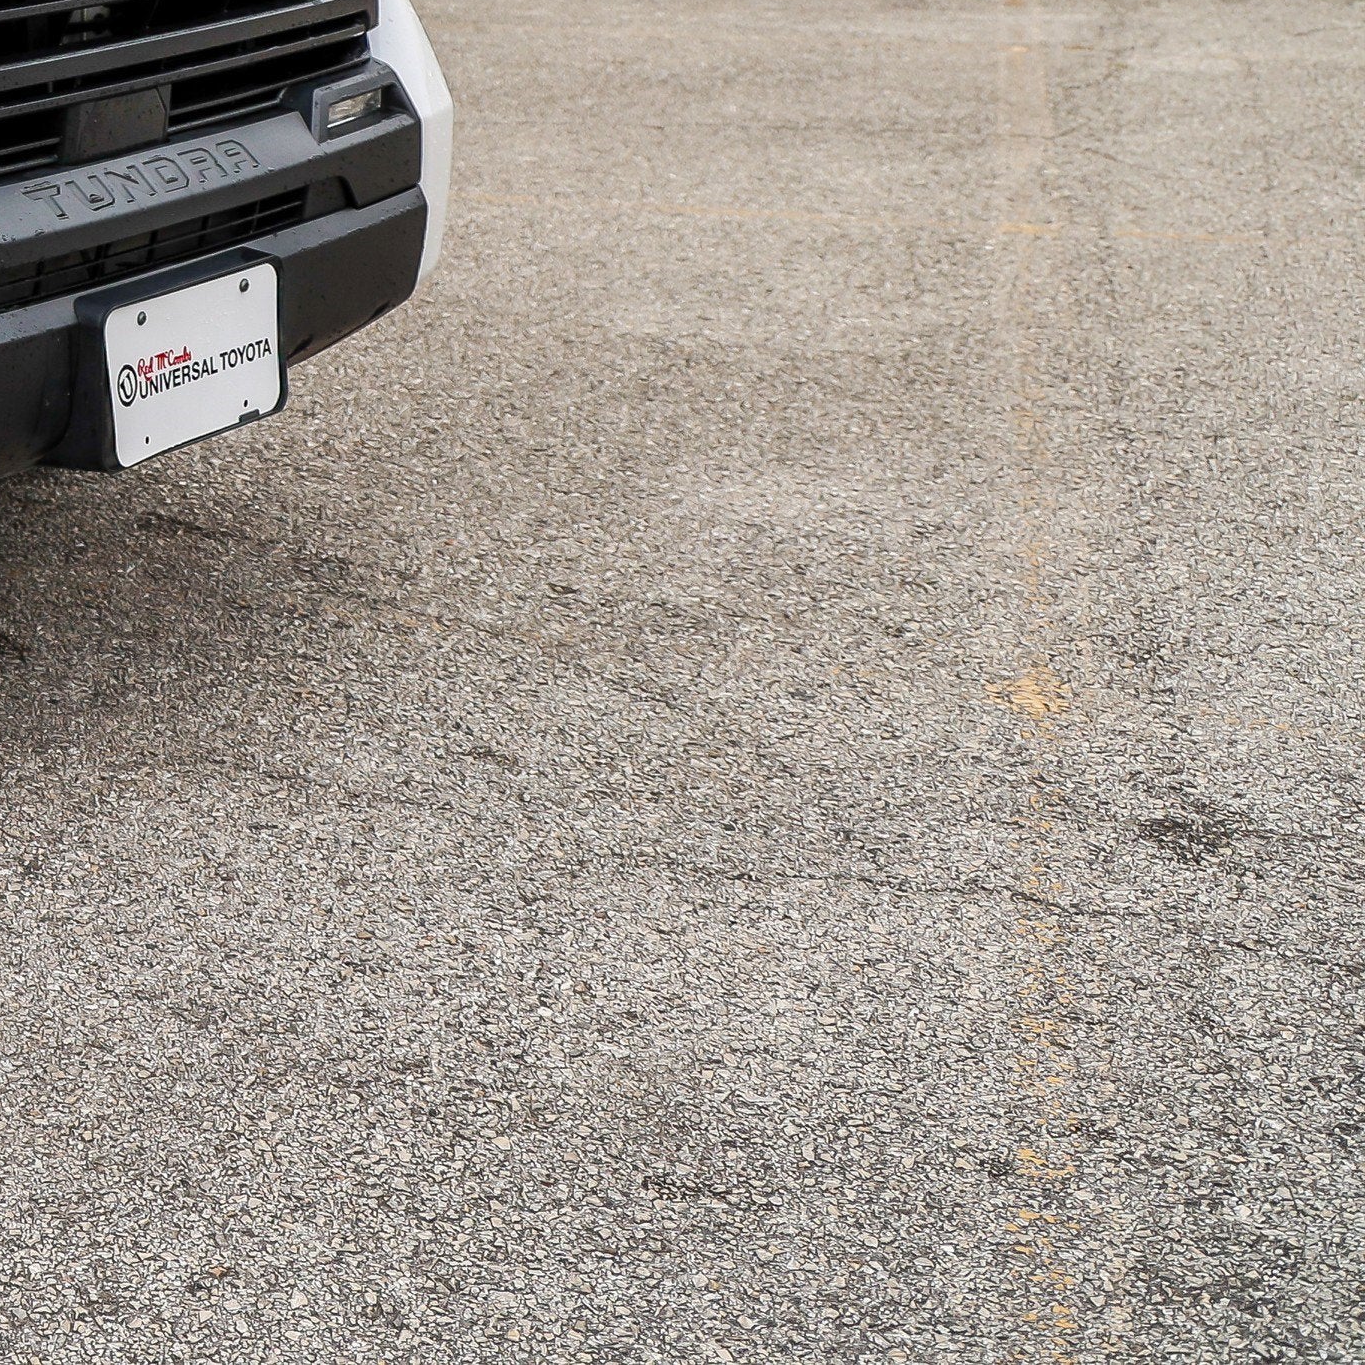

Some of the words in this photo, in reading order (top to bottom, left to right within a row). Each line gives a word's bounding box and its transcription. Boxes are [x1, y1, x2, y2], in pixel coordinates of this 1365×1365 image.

[21, 139, 262, 220] TUNDRA
[138, 355, 218, 400] UNIVERSAL
[219, 337, 272, 371] TOYOTA
